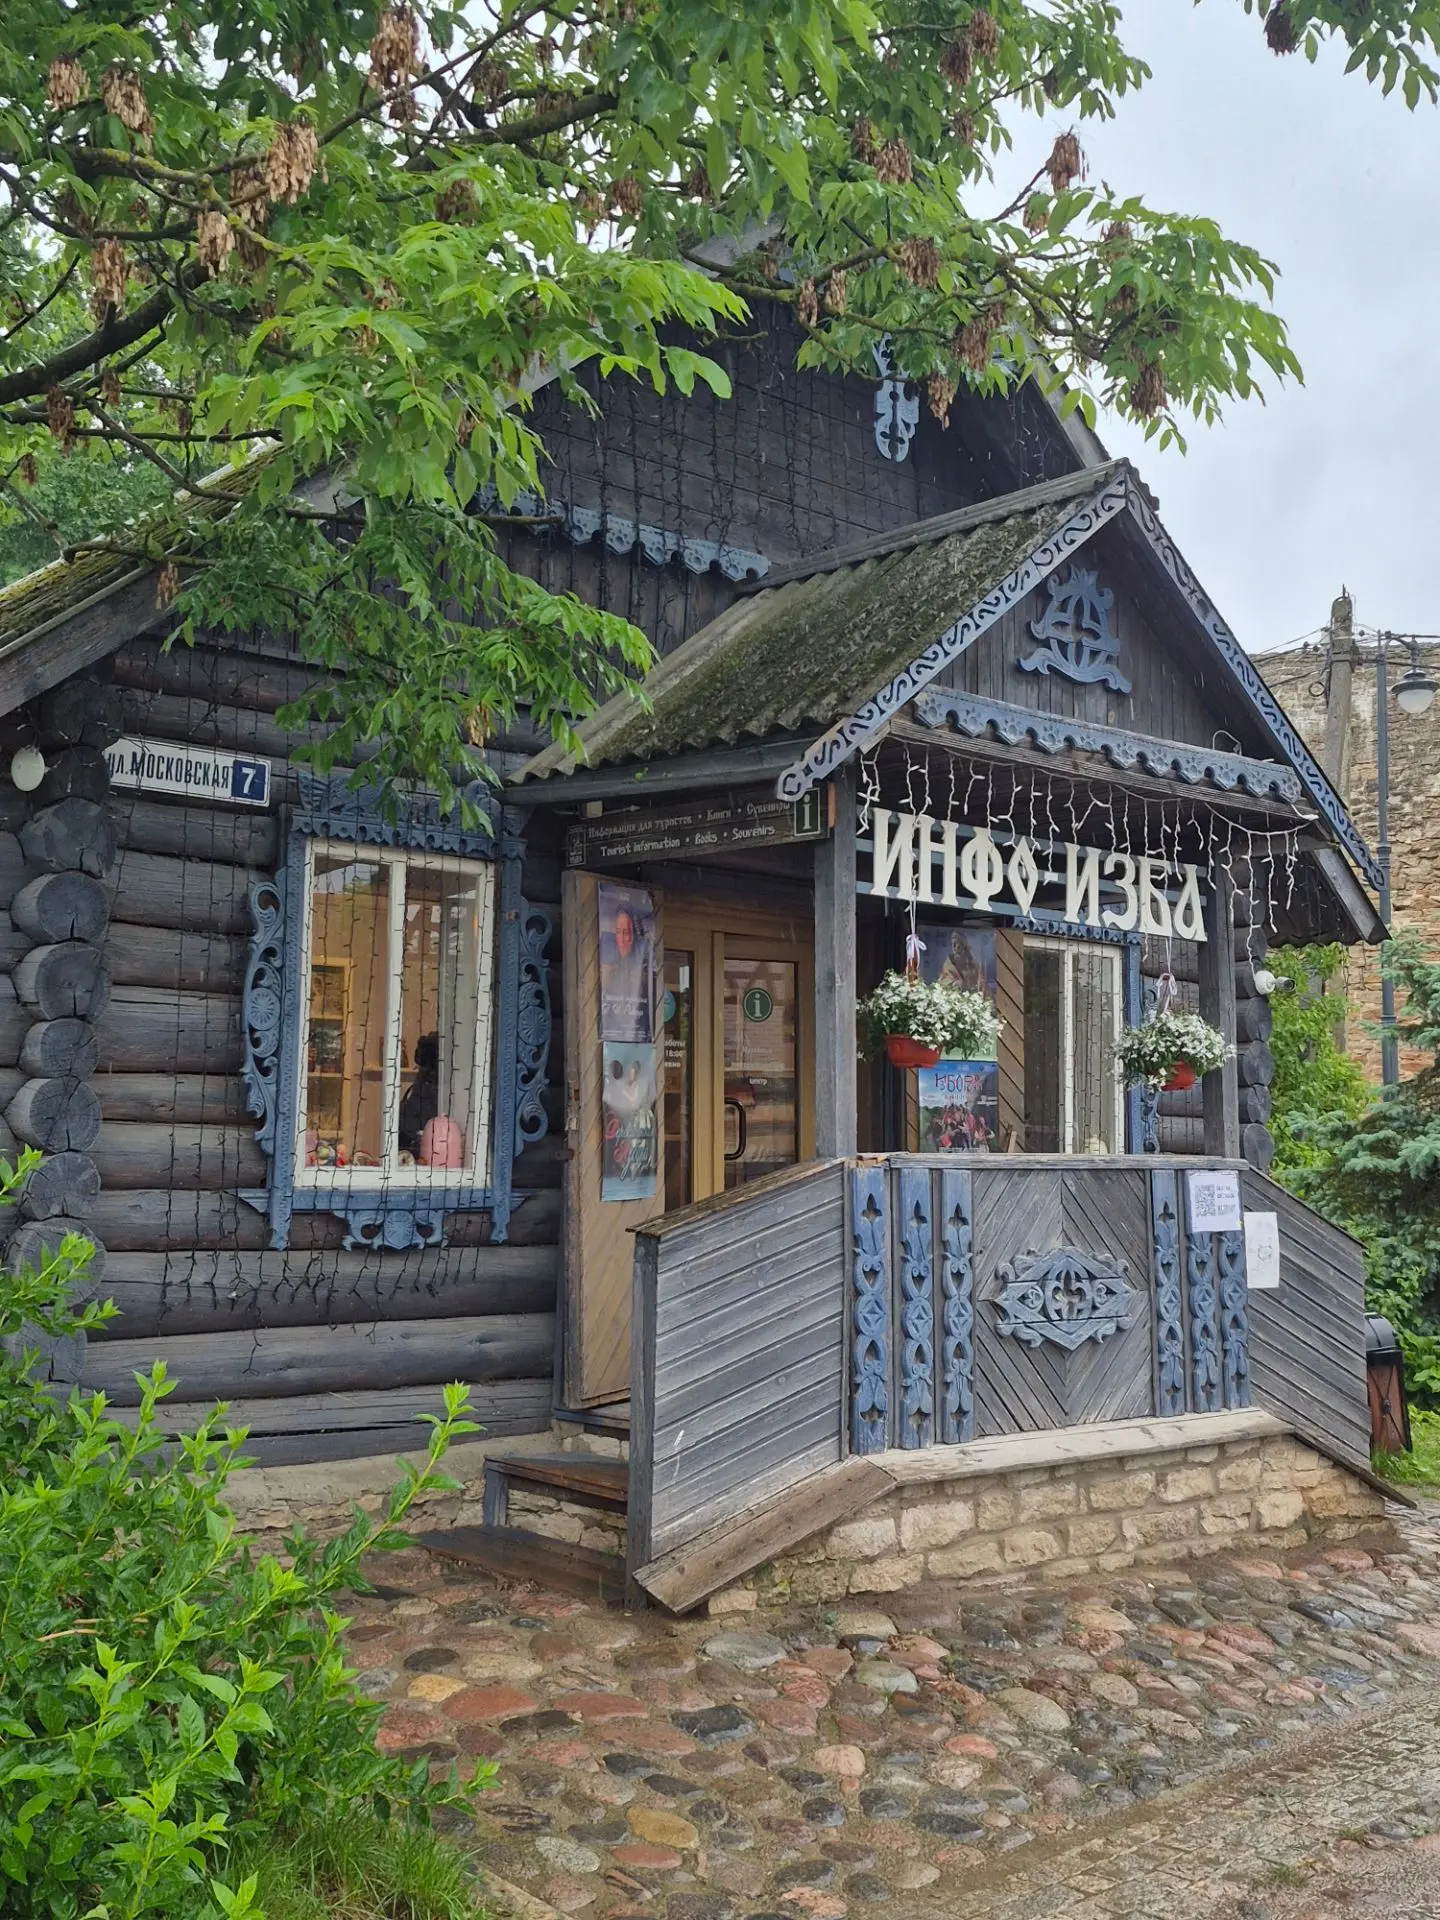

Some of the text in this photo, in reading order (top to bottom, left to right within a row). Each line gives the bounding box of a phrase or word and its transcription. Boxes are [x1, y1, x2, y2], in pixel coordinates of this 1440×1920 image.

[240, 767, 257, 795] 7
[600, 823, 776, 857] Tourist information Books Souvenirs
[869, 806, 1208, 942] ИНФО-ИЗБА
